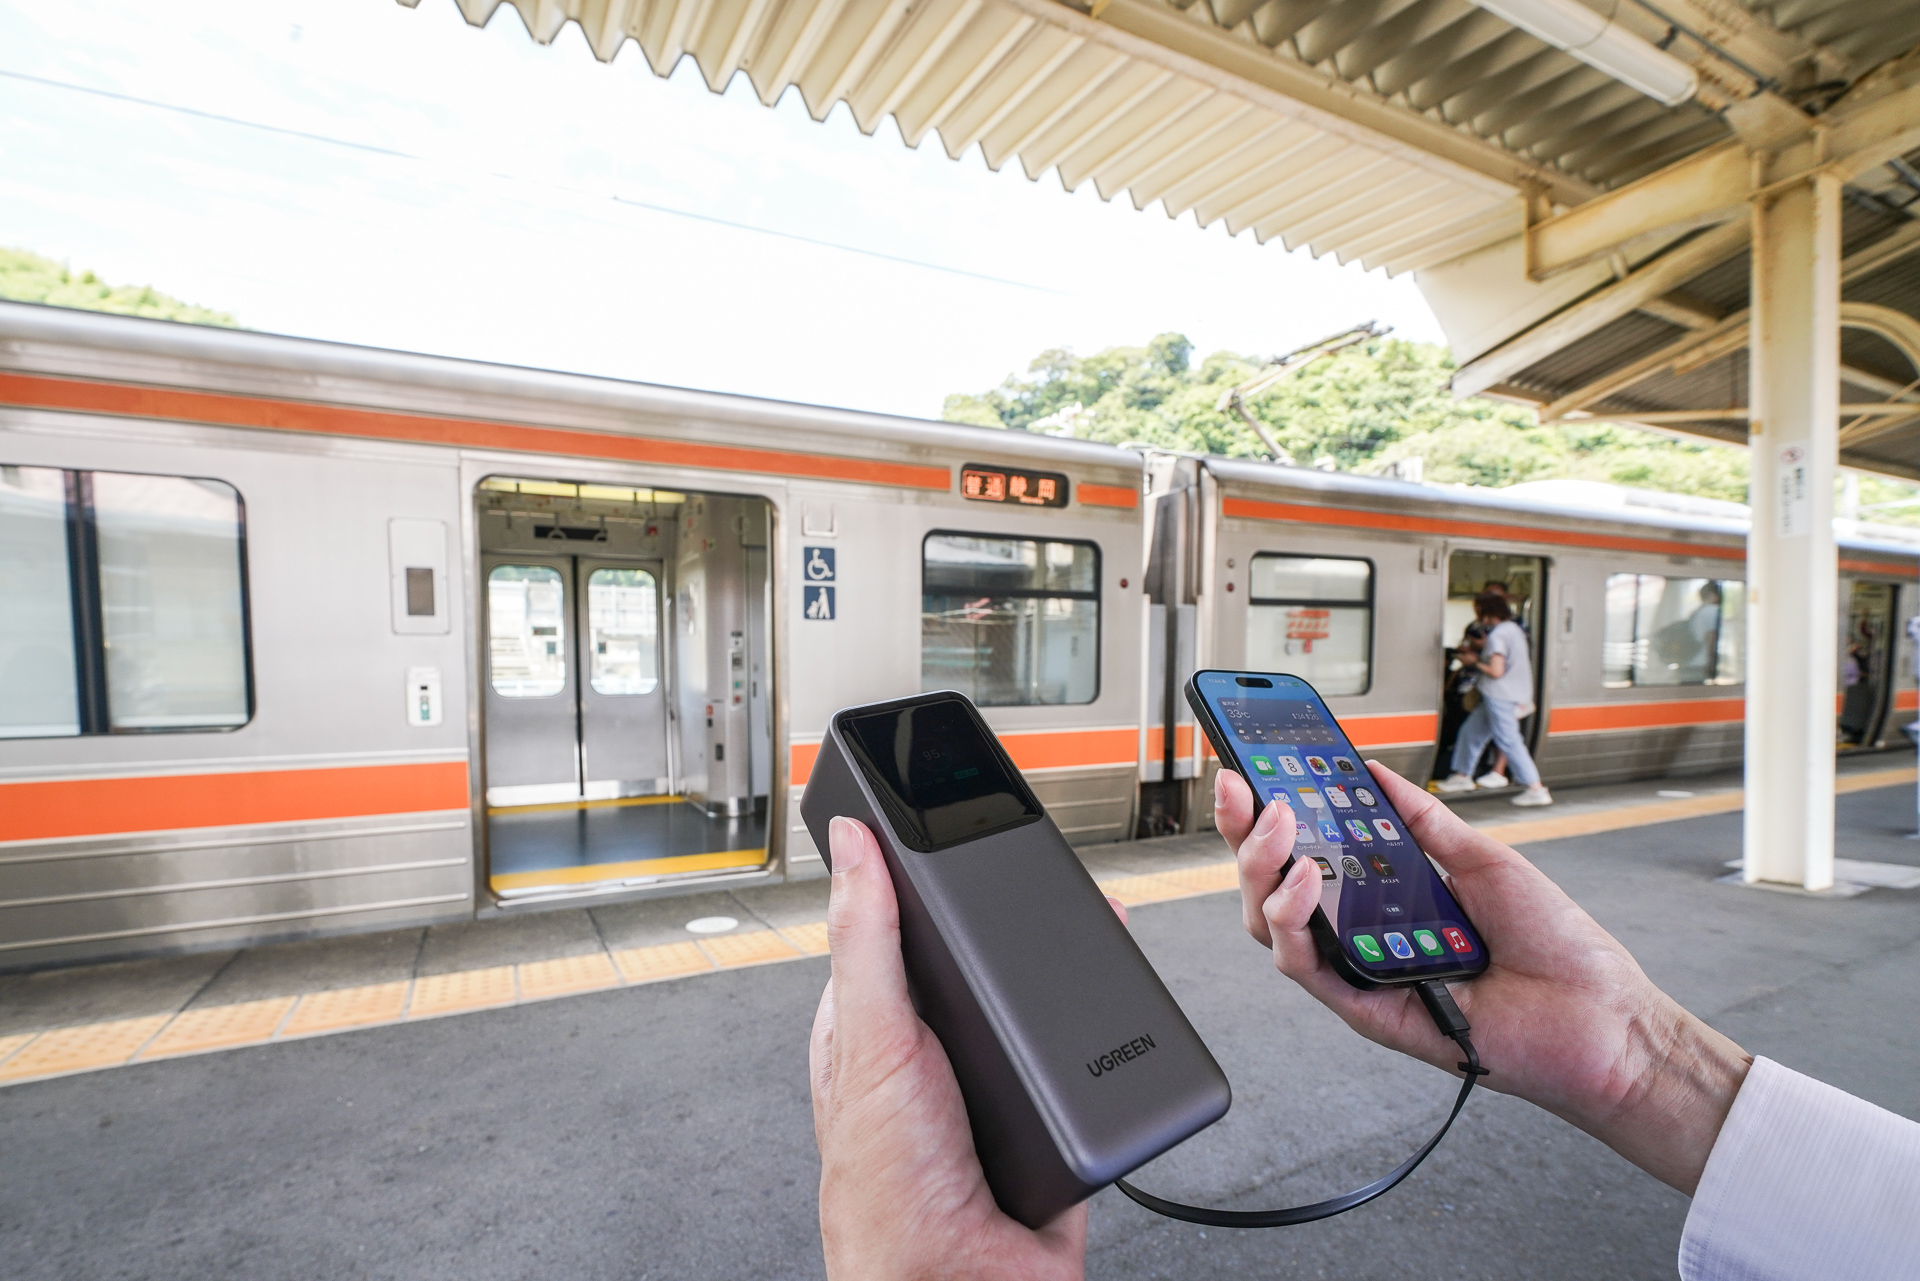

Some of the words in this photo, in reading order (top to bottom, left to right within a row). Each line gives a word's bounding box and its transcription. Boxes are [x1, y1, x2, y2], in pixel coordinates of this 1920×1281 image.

[966, 474, 1002, 498] 普通
[1009, 475, 1056, 501] 静岡
[1086, 1033, 1157, 1078] UGREEN
